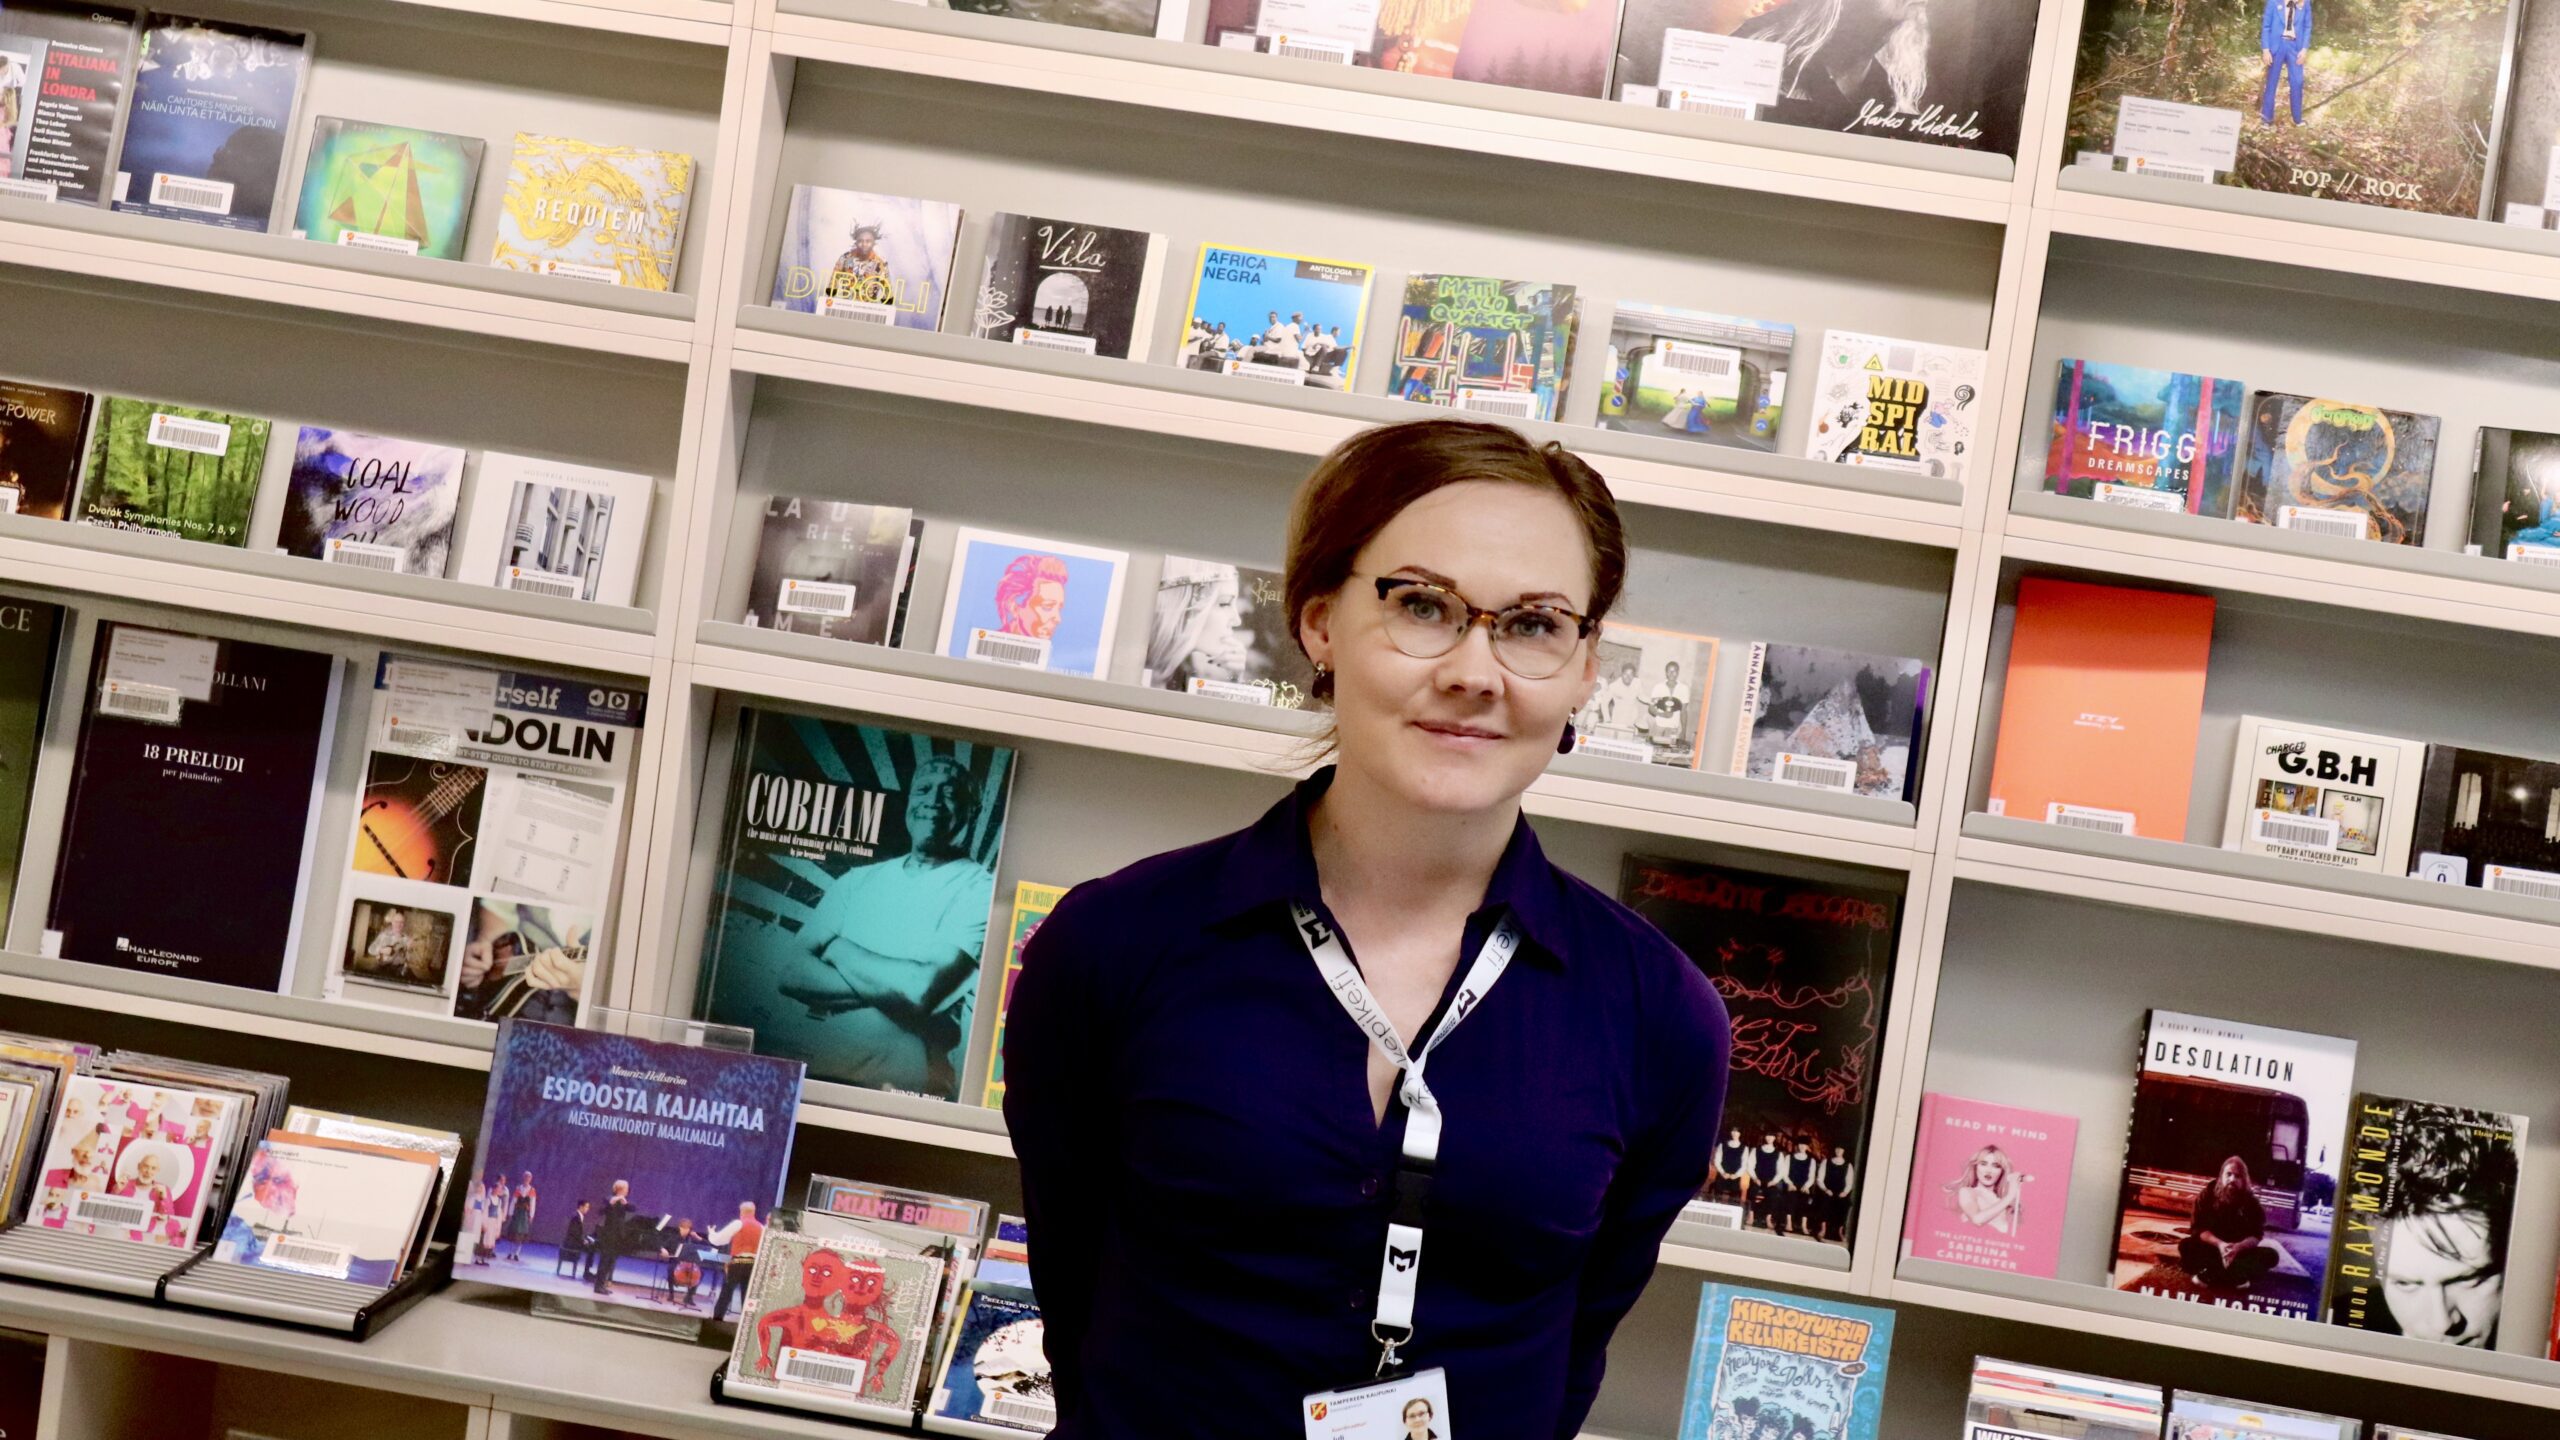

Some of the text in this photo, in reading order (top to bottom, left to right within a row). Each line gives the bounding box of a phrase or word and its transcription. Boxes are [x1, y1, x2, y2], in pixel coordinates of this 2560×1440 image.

[45, 66, 61, 80] IN
[48, 51, 118, 72] L'ITALIANA
[42, 82, 97, 101] LONDRA
[141, 101, 277, 129] NÄIN UNTA ETTÄ LAULOIN
[167, 95, 254, 115] CANTORES MINORES
[1842, 98, 1983, 141] Marko Hietala
[2289, 168, 2332, 190] POP
[2363, 177, 2424, 202] ROCK
[534, 198, 646, 235] REQUIEM
[1037, 225, 1107, 268] Vila
[1204, 266, 1262, 285] NEGRA
[1309, 264, 1353, 277] ANTOLOGIA
[784, 265, 930, 314] DIBOLI
[1441, 277, 1500, 297] MATTI
[1432, 303, 1533, 329] QUARTET
[1454, 296, 1506, 312] SALO
[1867, 374, 1929, 404] MID
[6, 403, 56, 425] POWER
[1867, 402, 1918, 430] SPI
[1858, 427, 1919, 457] RAL
[2087, 420, 2198, 464] FRIGG
[346, 457, 413, 494] COAL
[2088, 458, 2191, 481] DREAMSCAPES
[88, 503, 237, 537] Dvořák Symphonies Nos. 7, 8, 9
[334, 497, 405, 525] WOOD
[86, 516, 182, 539] Czech Philharmonic
[212, 671, 268, 692] OLLANI
[142, 743, 246, 774] 18 PRELUDI
[2265, 741, 2306, 756] CHARGED
[162, 767, 223, 784] per pianoforte
[491, 754, 518, 766] GUIDE
[518, 756, 531, 766] TO
[530, 759, 556, 770] START
[556, 762, 594, 777] PLAYING
[746, 771, 888, 845] COBHAM
[747, 827, 874, 857] the music and drumming of billy cobham
[2265, 843, 2281, 853] CITY
[2281, 846, 2299, 857] BABY
[2298, 848, 2333, 862] ATTACKED
[2332, 853, 2342, 862] BY
[2341, 855, 2359, 866] RATS
[136, 954, 180, 969] EUROPE
[2154, 1041, 2294, 1082] DESOLATION
[645, 1068, 688, 1086] Hellström
[542, 1075, 765, 1133] ESPOOSTA KAJAHTAA
[567, 1110, 726, 1149] MESTARIKUOROT MAAILMALLA
[1945, 1116, 2049, 1142] READ MY MIND
[2473, 1129, 2513, 1141] Elton John
[2341, 1104, 2394, 1278] RAYMONDE
[832, 1193, 899, 1221] MIAMI
[1935, 1229, 2026, 1251] THE LITTLE GUIDE TO
[1948, 1240, 2009, 1259] SABRINA
[1936, 1249, 2018, 1270] CARPENTER
[980, 1293, 1017, 1307] PRELUDE
[2248, 1294, 2265, 1303] WITH
[2266, 1296, 2281, 1306] BEN
[1731, 1299, 1871, 1344] KIRJOITUKSIA
[1727, 1318, 1865, 1362] KELLAREISTA
[1330, 1388, 1398, 1407] TAMPEREEN KAUPUNKI
